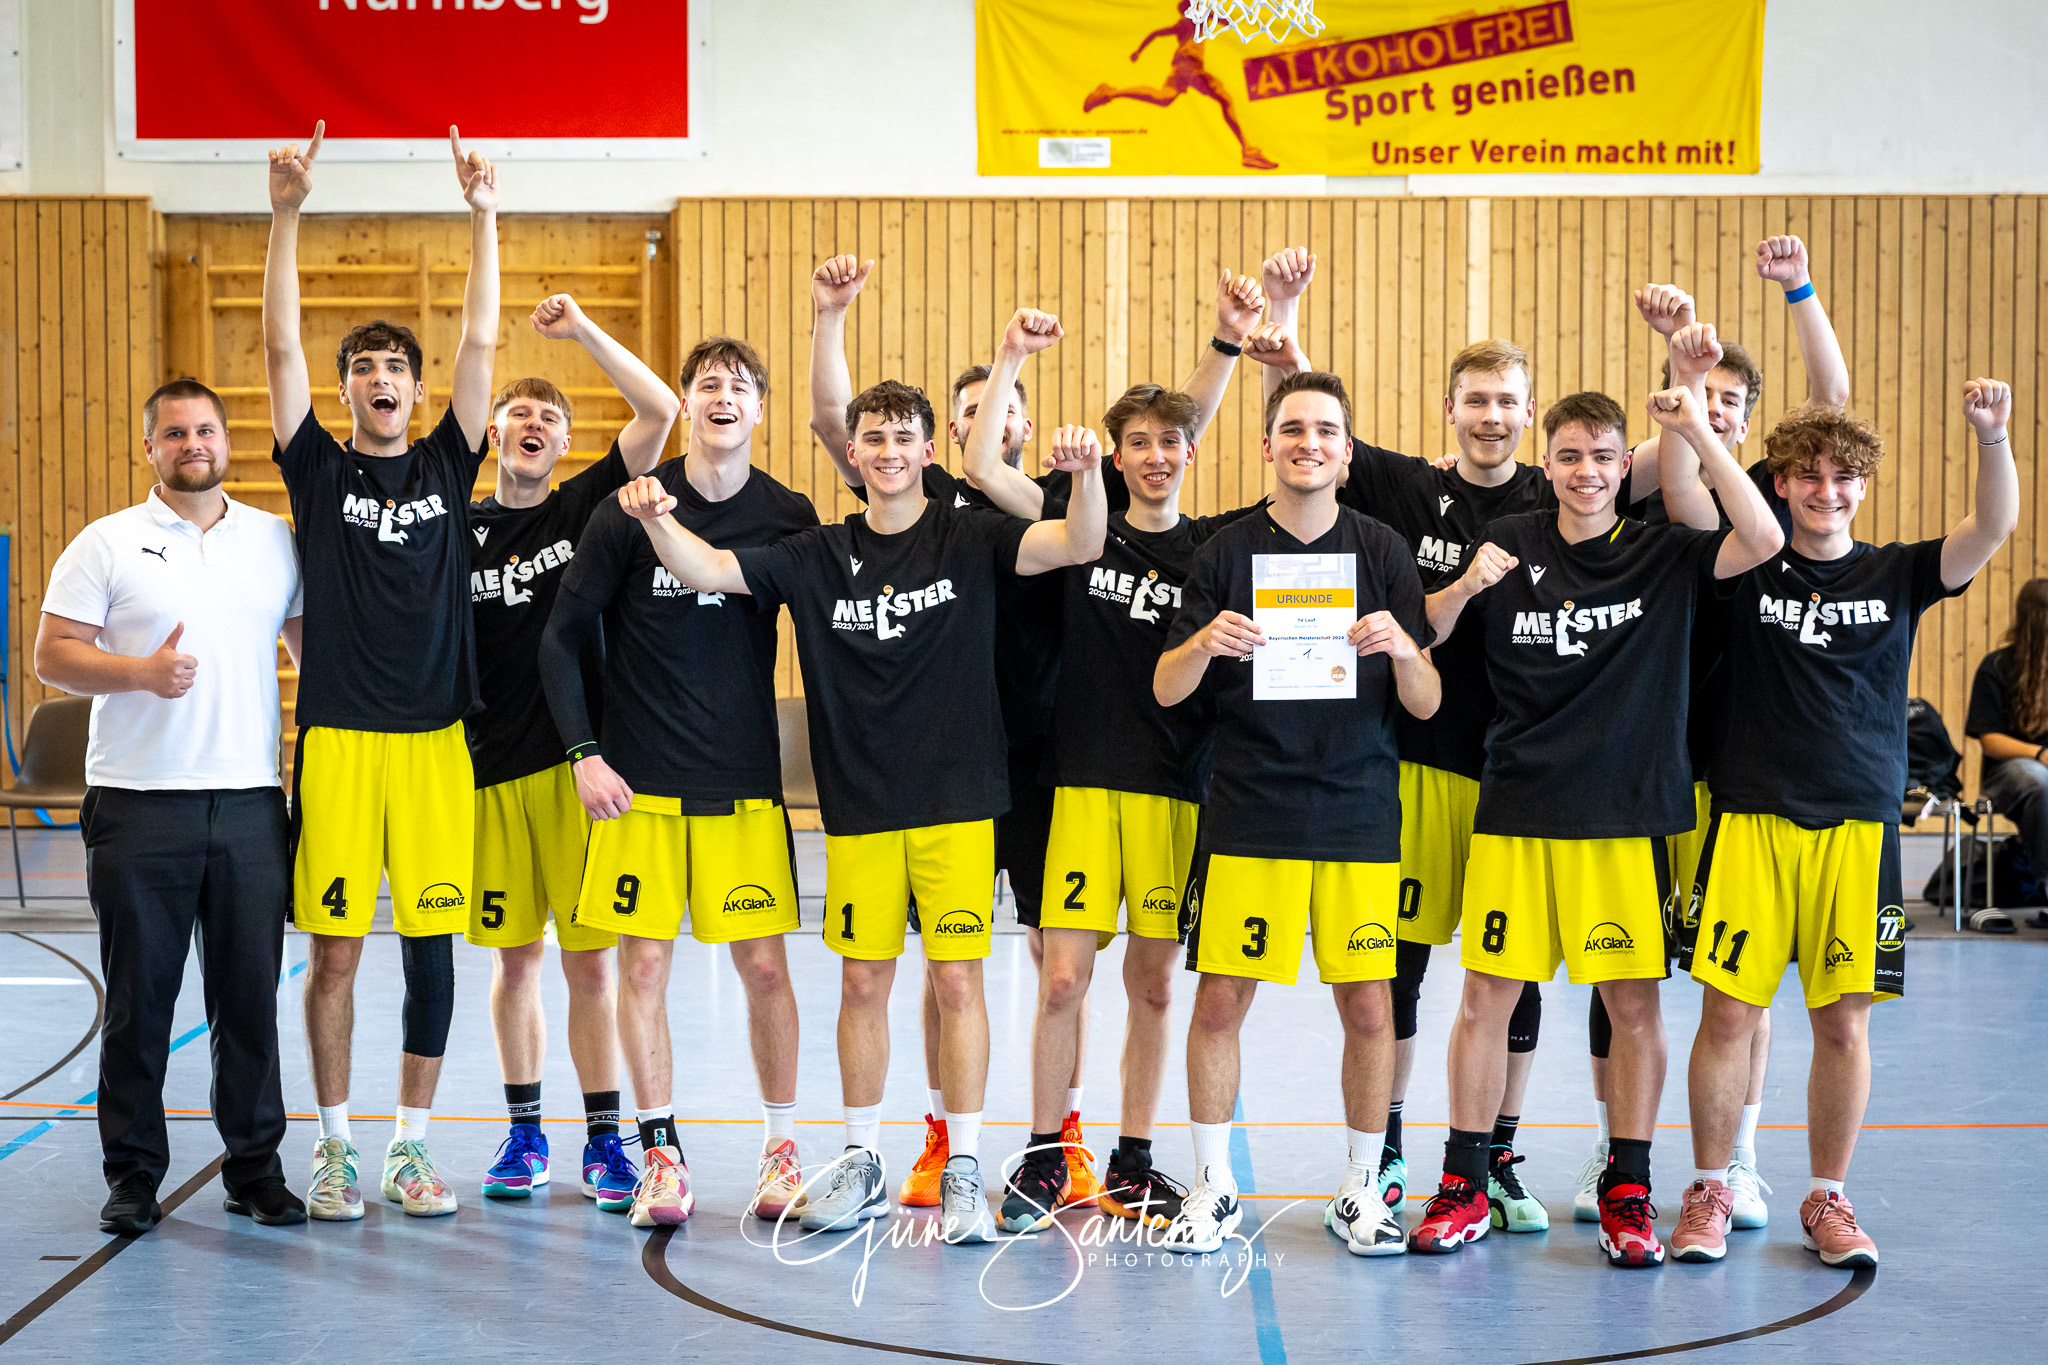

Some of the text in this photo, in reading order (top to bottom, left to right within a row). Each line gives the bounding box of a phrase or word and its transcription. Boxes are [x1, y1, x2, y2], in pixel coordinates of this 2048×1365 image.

[1255, 5, 1567, 96] ALKOHOLFREI
[1325, 63, 1637, 125] Sport genießen
[1371, 139, 1736, 165] Unser Verein macht mit!
[1088, 587, 1131, 605] 2023/2024
[1277, 594, 1333, 604] URKUNDE
[831, 621, 875, 632] 2023/2024
[1511, 635, 1554, 645] 2023/2024
[321, 876, 349, 920] 4
[481, 890, 508, 931] 5
[612, 873, 642, 918] 9
[1063, 871, 1087, 912] 2
[841, 902, 856, 942] 1
[1242, 916, 1269, 960] 3
[1482, 910, 1509, 956] 8
[1707, 920, 1750, 977] 11
